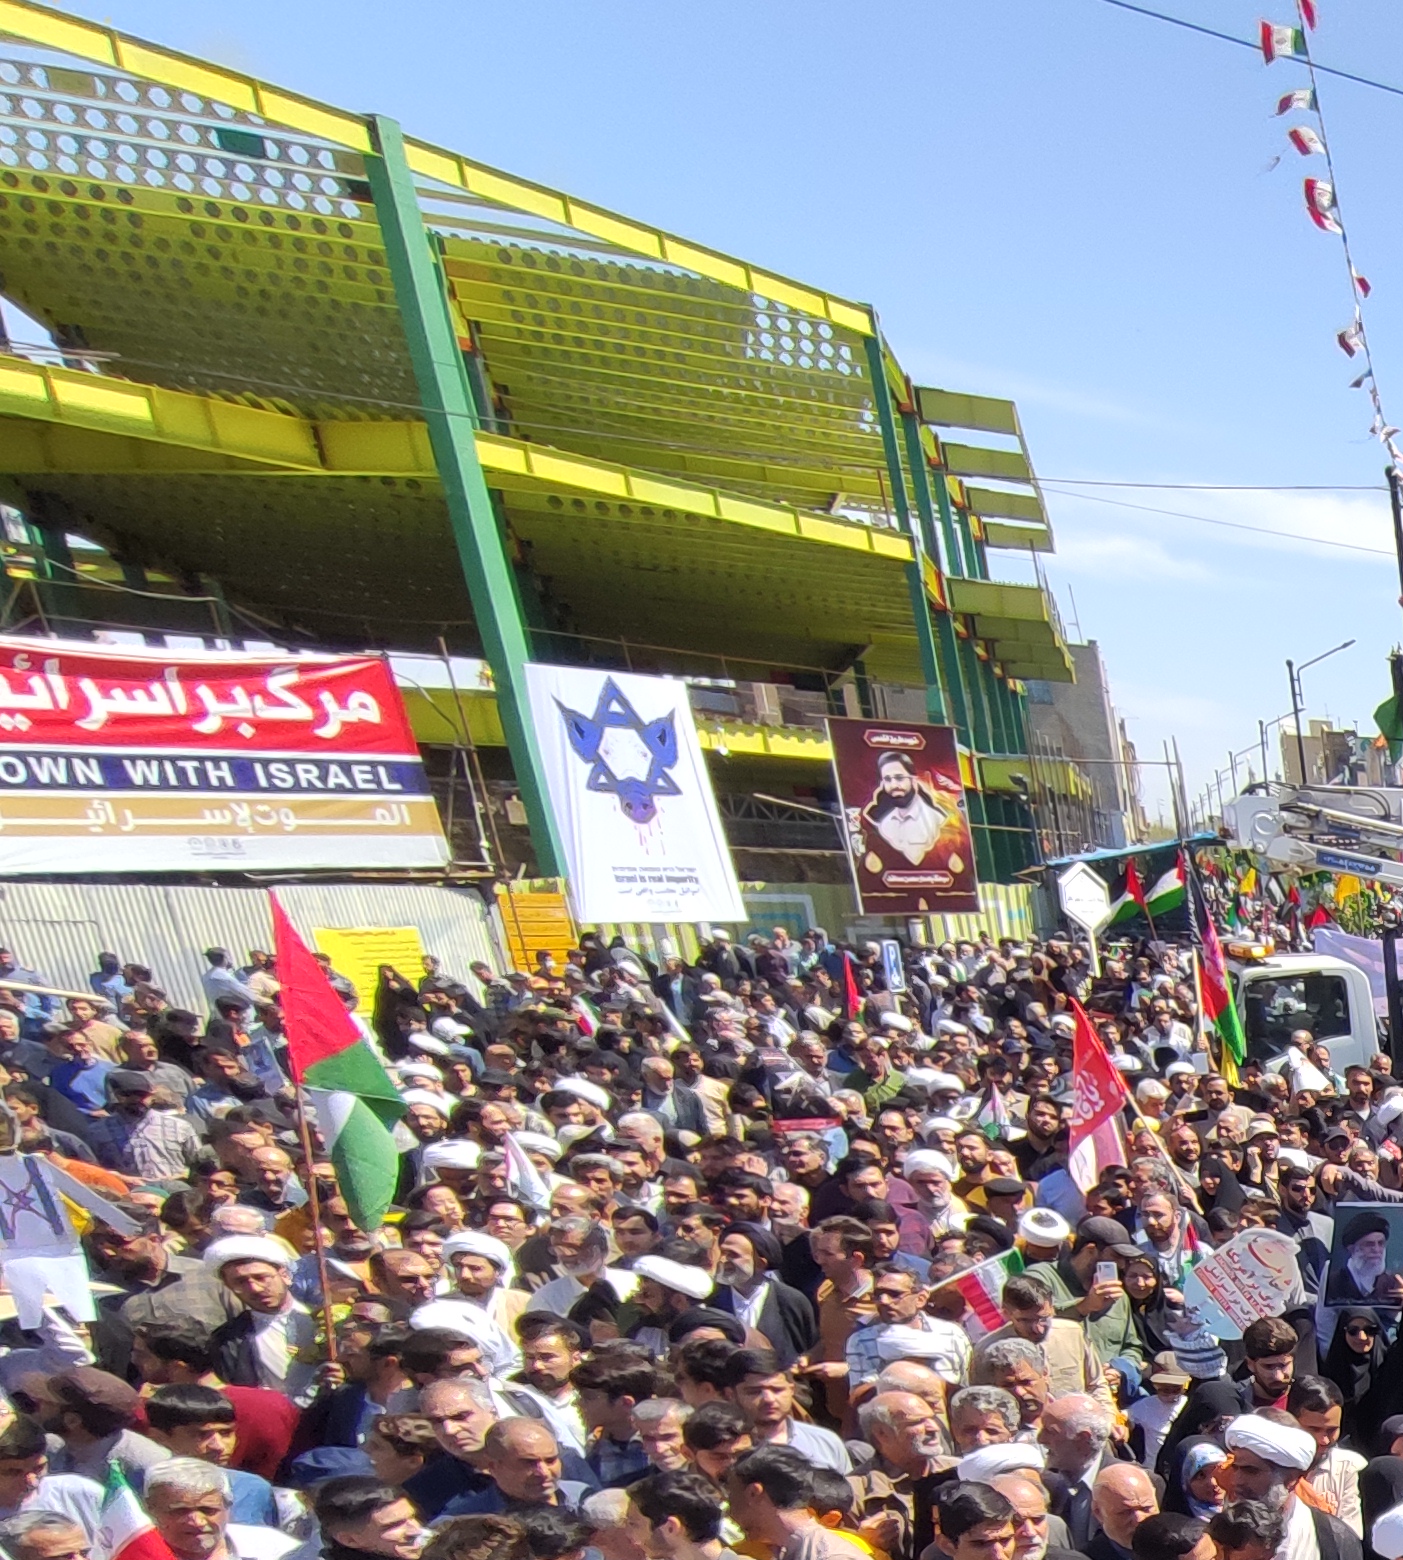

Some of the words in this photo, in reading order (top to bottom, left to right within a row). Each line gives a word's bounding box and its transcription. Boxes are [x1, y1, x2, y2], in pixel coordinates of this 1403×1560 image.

[0, 653, 188, 732] اسرائی
[193, 682, 257, 739] بر
[254, 663, 382, 739] مرگ
[122, 758, 236, 788] WITH
[254, 762, 403, 791] ISRAEL
